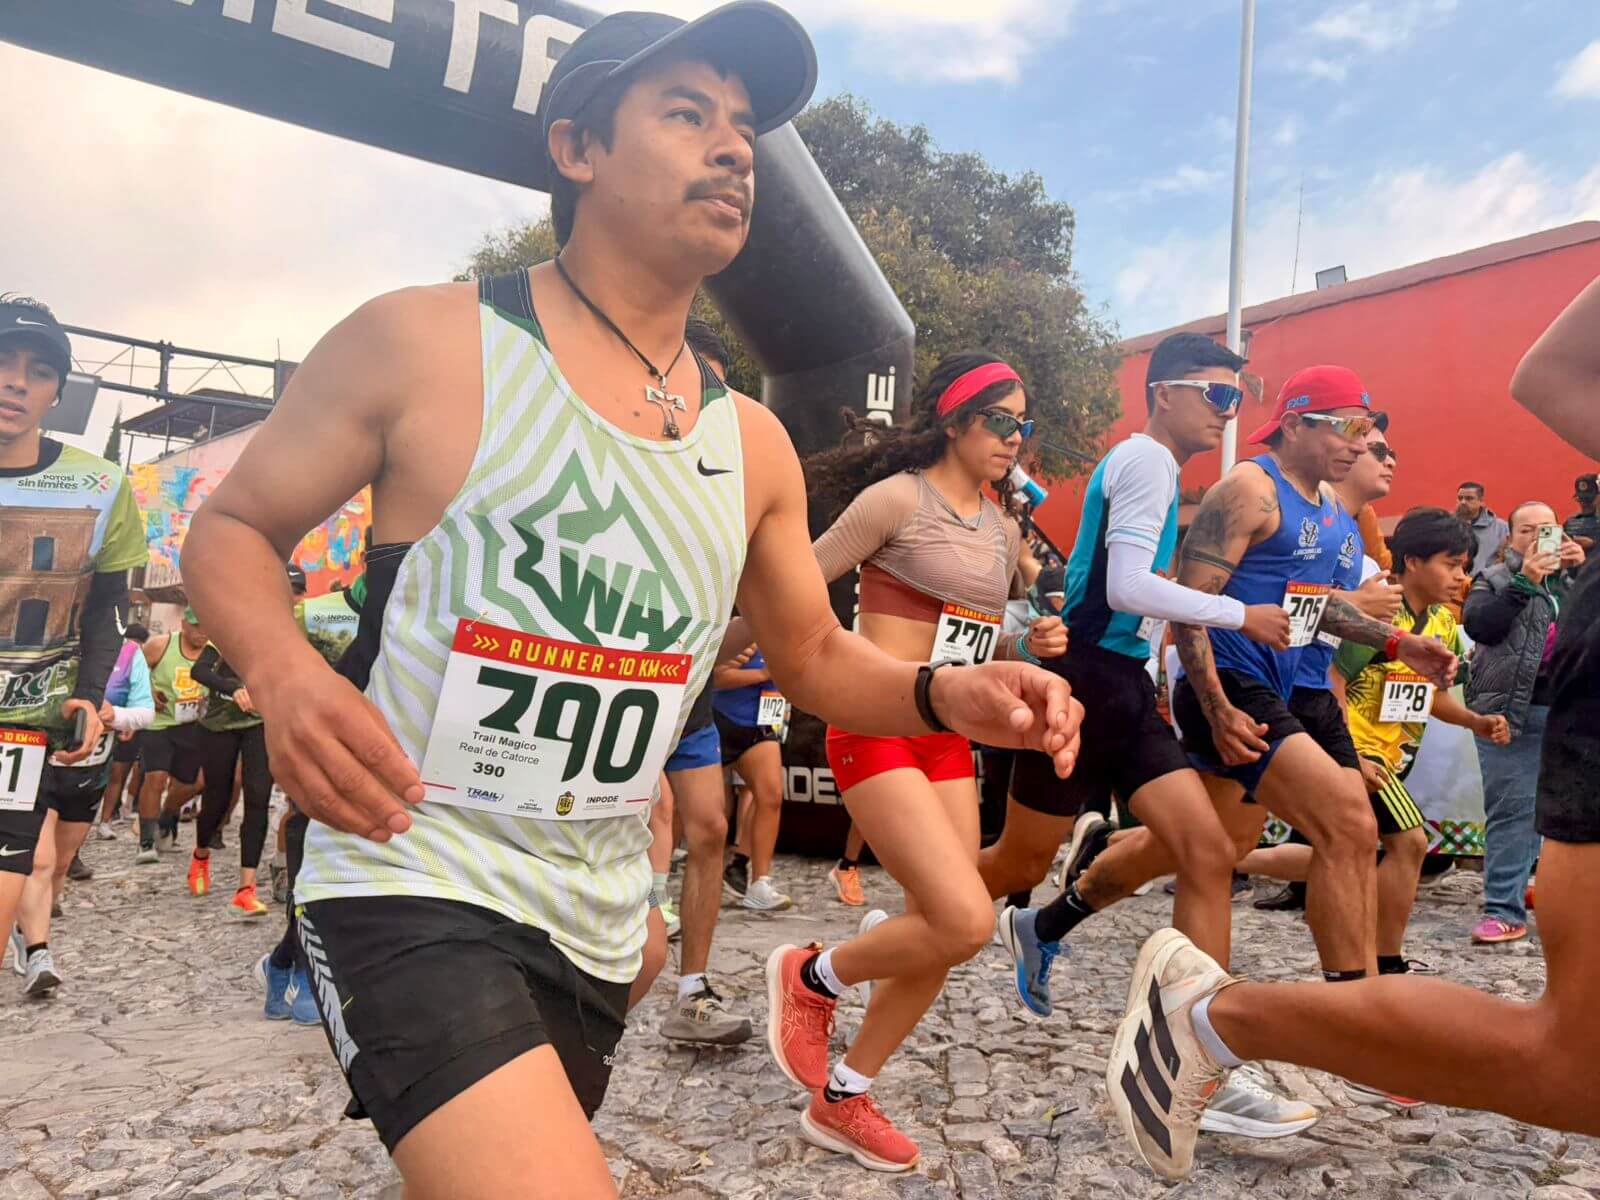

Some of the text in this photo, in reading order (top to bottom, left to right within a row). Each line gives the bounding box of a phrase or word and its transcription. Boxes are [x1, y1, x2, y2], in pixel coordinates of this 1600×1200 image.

[17, 479, 36, 488] sin
[945, 617, 994, 665] 770
[508, 638, 661, 678] RUNNER 10 KM
[477, 665, 660, 784] 790
[5, 732, 28, 743] 10 KM
[473, 731, 537, 751] Trail Magico
[459, 742, 540, 765] Real de Catorce
[0, 746, 24, 793] 1
[472, 762, 505, 778] 390
[467, 786, 500, 800] TRAIL
[586, 795, 619, 804] INPODE
